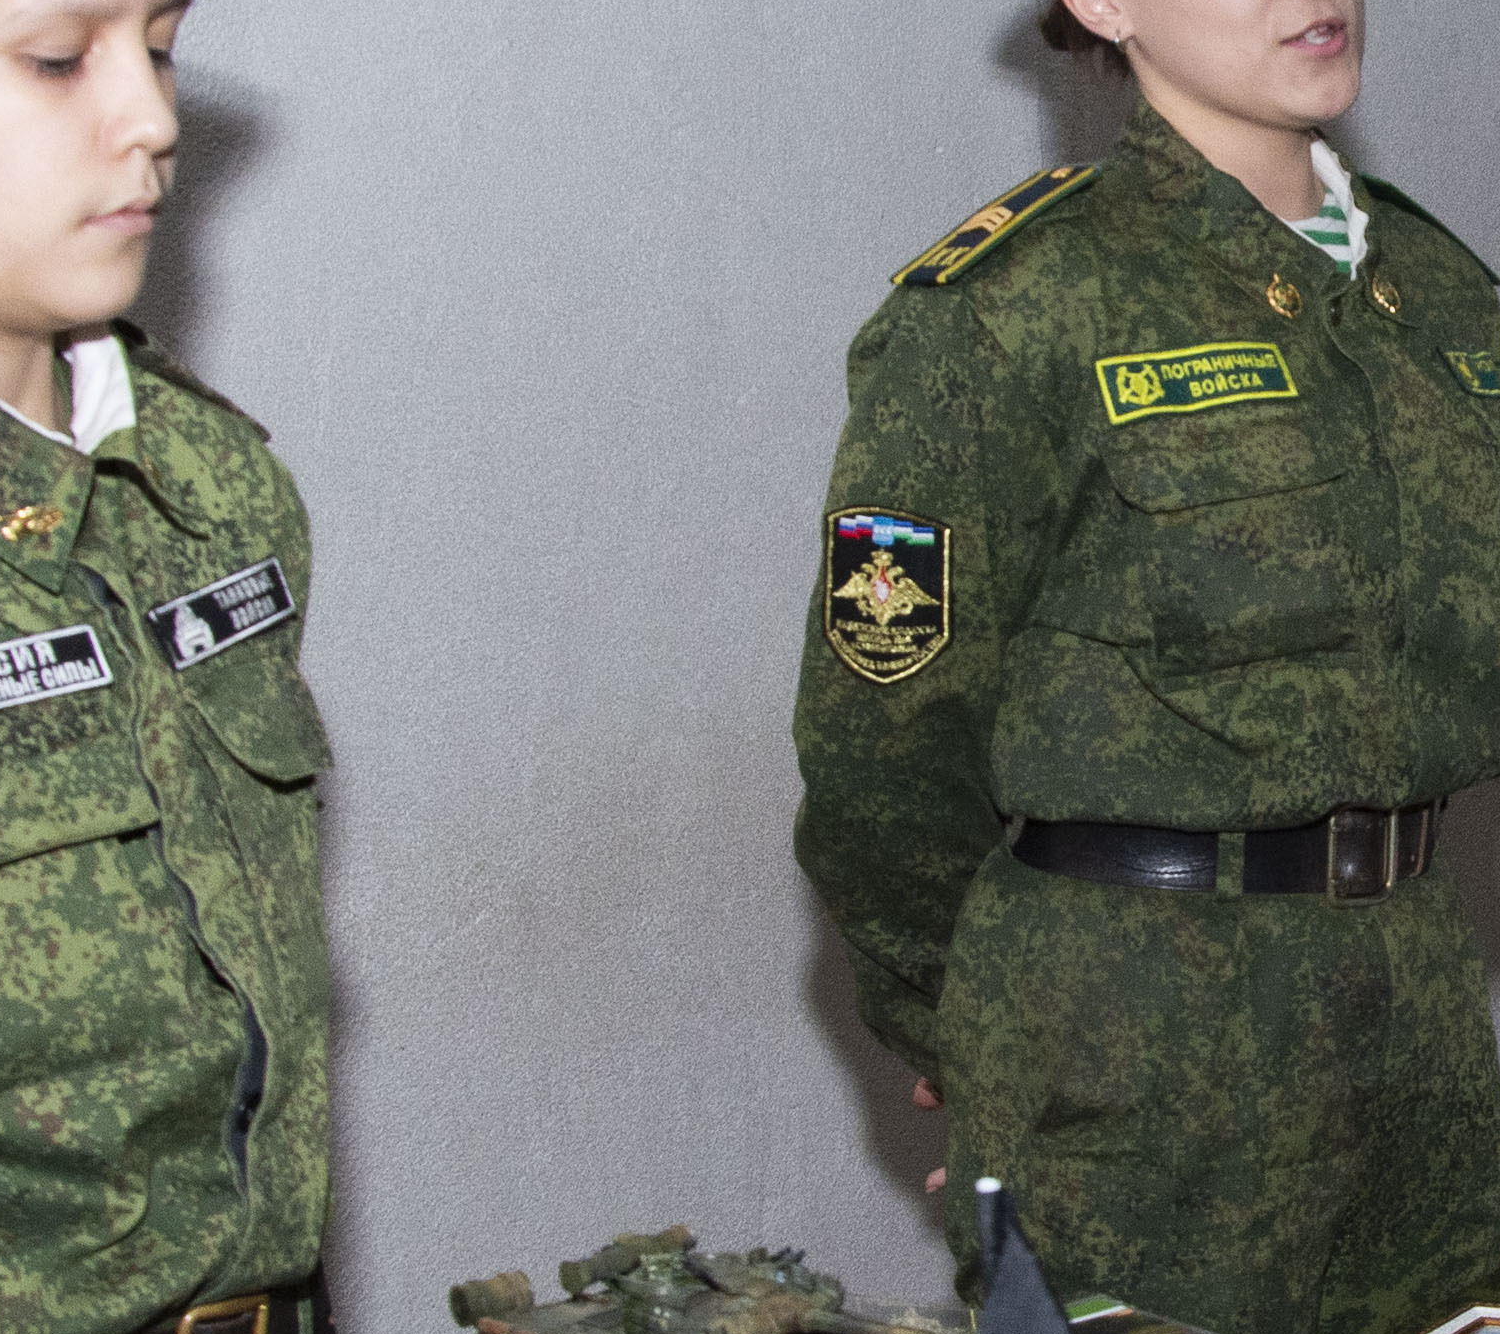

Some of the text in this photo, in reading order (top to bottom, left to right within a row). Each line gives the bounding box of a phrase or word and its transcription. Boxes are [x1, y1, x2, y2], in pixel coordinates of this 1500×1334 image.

[1160, 353, 1277, 380] ПОГРАНИЧНЫЕ
[1189, 372, 1263, 398] ВОЙСКА
[40, 656, 100, 689] СИЛЫ
